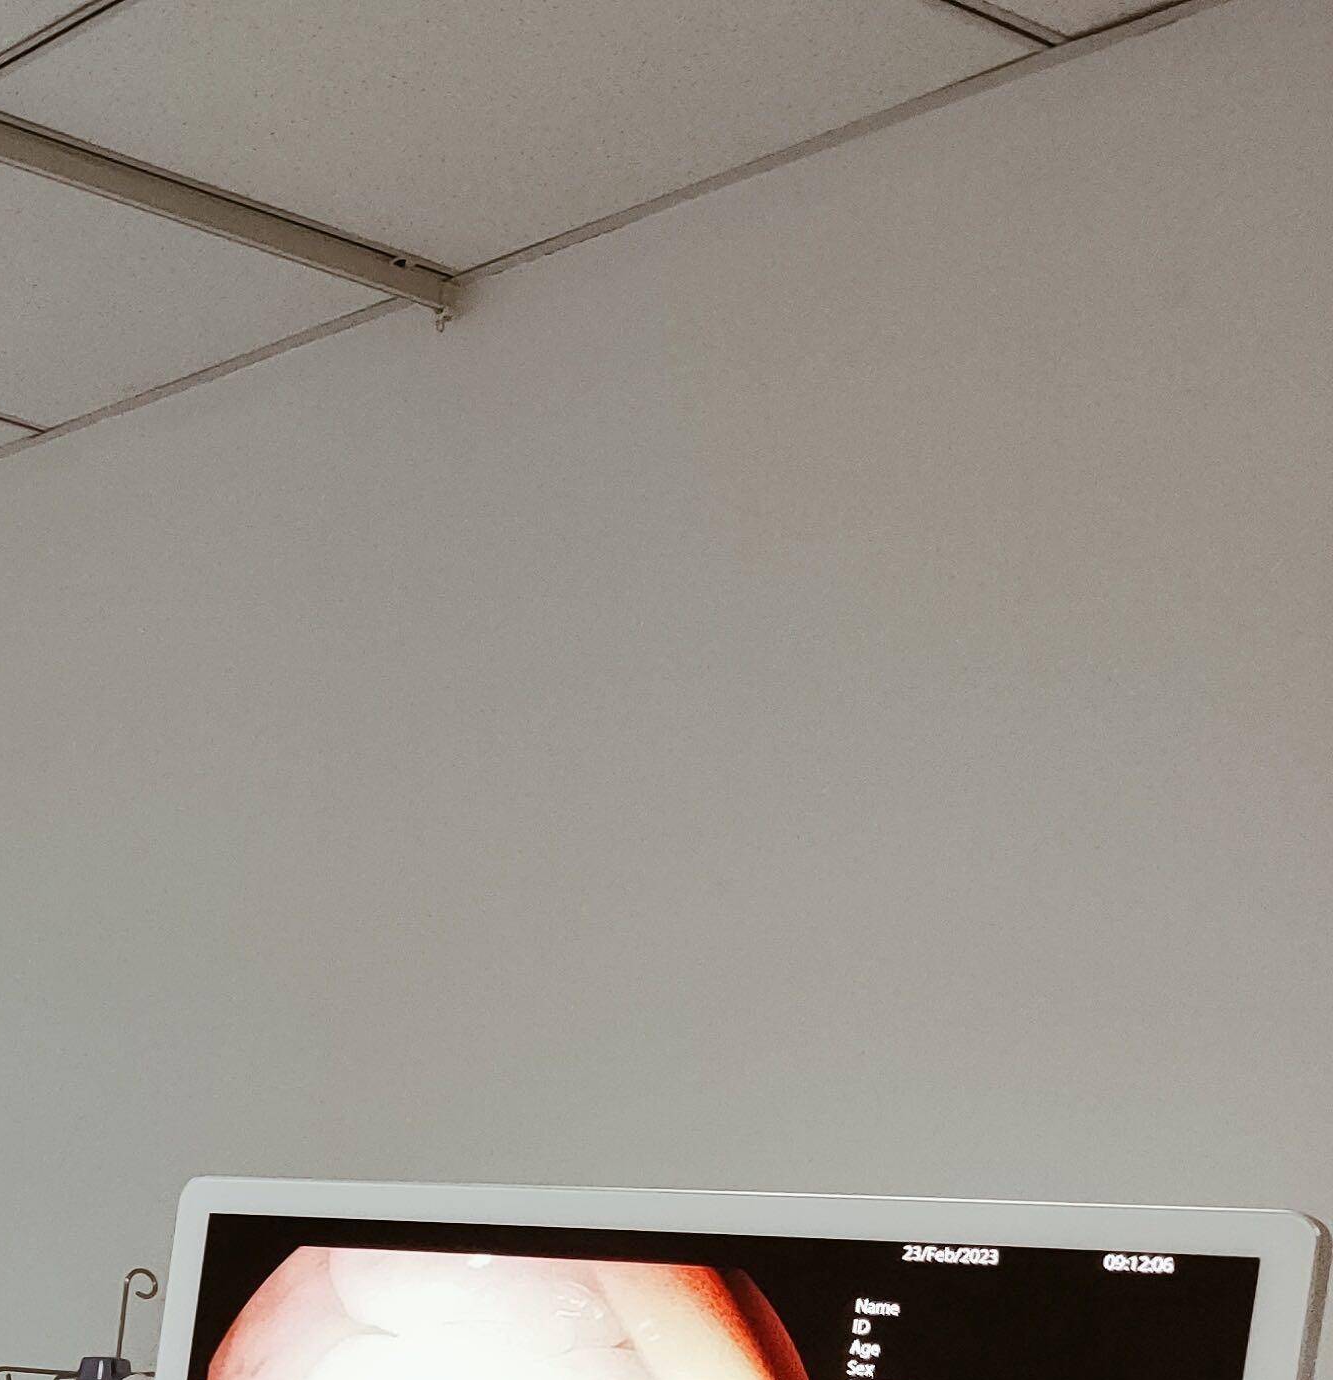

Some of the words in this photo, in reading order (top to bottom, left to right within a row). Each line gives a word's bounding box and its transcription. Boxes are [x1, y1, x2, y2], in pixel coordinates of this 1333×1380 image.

[901, 1244, 1000, 1267] 23/Feb/2023
[1102, 1253, 1175, 1275] 09:12:06
[854, 1297, 901, 1317] Name
[851, 1318, 872, 1336] ID
[848, 1338, 881, 1360] Age
[846, 1359, 876, 1380] Sex
